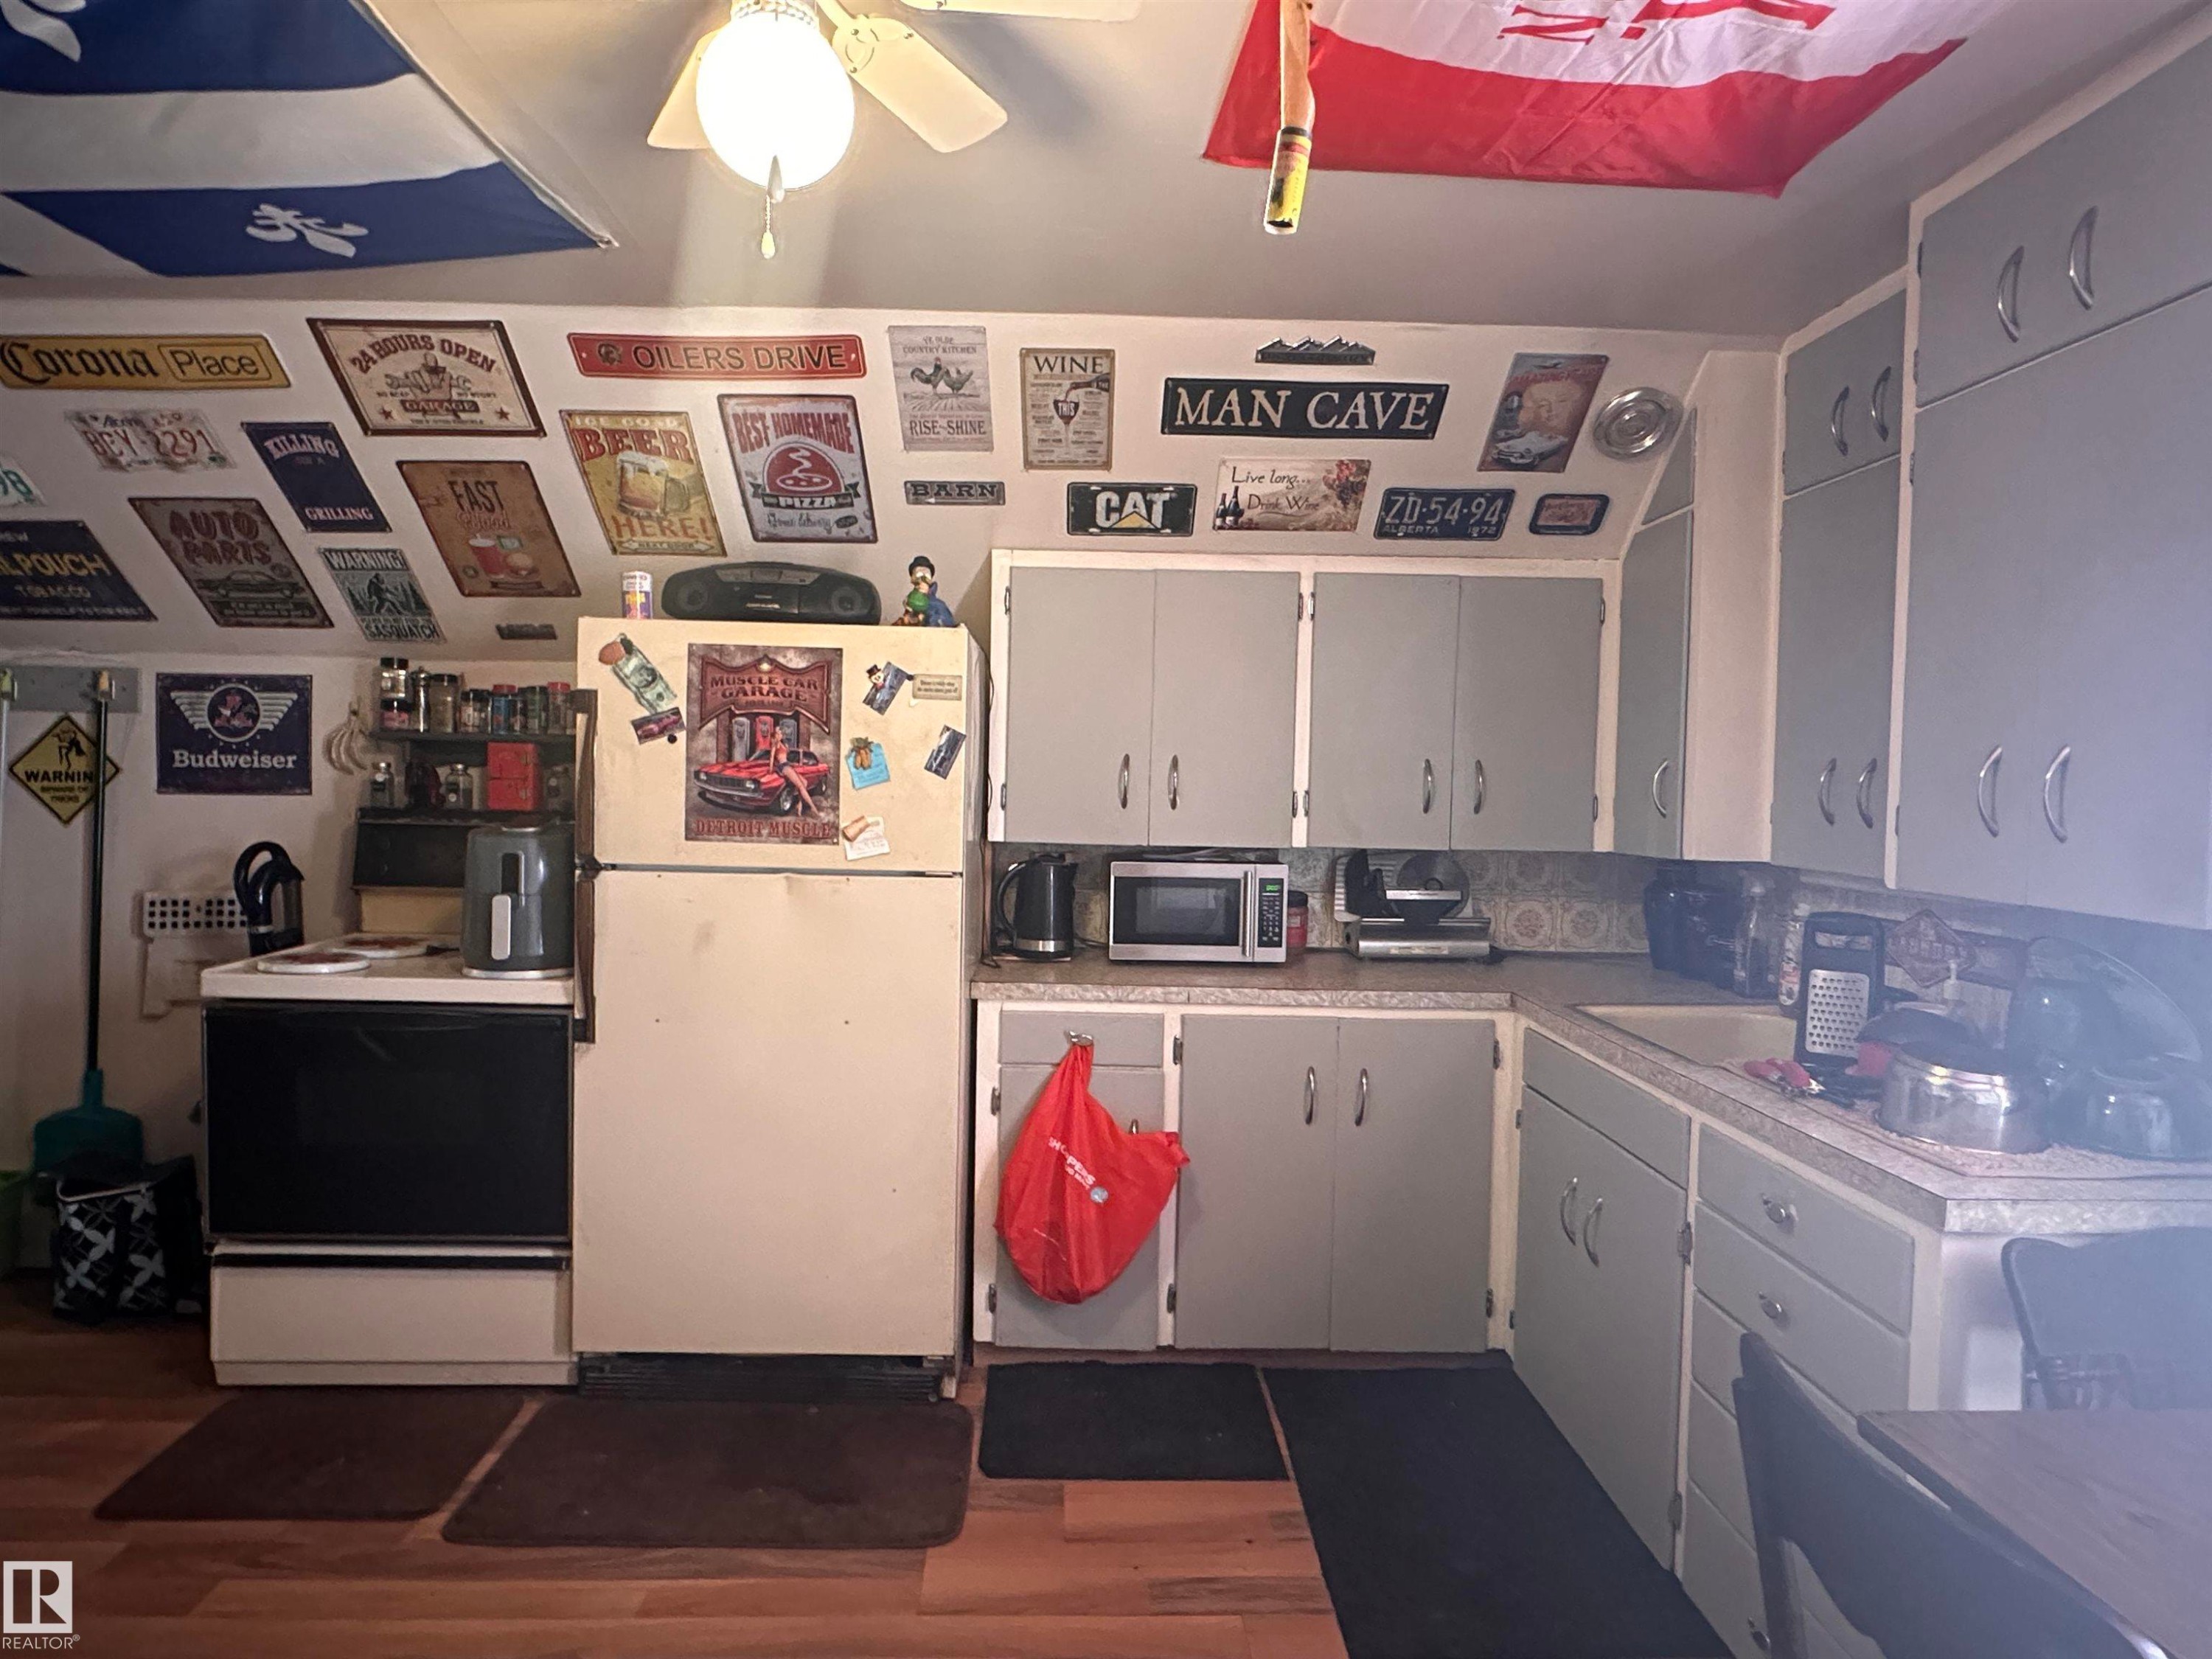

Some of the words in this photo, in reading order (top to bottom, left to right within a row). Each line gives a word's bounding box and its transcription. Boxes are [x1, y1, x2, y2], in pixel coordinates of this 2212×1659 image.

[351, 349, 378, 374] 24
[369, 334, 435, 359] HOURS
[440, 338, 496, 372] OPEN
[633, 344, 744, 369] OILERS
[754, 344, 847, 369] DRIVE
[903, 346, 940, 354] COUNTRY
[942, 346, 977, 354] KITCHEN
[0, 342, 159, 384] Corona
[170, 349, 259, 377] Place
[1034, 355, 1104, 373] WINE
[406, 401, 476, 411] GARAGE
[1057, 402, 1076, 417] THIS
[1175, 387, 1292, 428] MAN
[1306, 391, 1434, 430] CAVE
[575, 415, 610, 425] ICE
[622, 417, 680, 428] COLD
[910, 420, 939, 436] RISE
[947, 420, 986, 435] SHINE
[732, 412, 770, 453] BEST
[771, 412, 855, 453] HOMEMADE
[572, 428, 695, 465] BEER
[1232, 466, 1265, 484] Live
[1270, 469, 1311, 490] long...
[448, 481, 504, 512] FAST
[911, 484, 997, 497] BARN
[778, 496, 837, 508] PIZZA
[1096, 491, 1171, 529] CAT
[1248, 494, 1282, 510] Drink
[1285, 495, 1320, 510] Wine
[305, 507, 374, 521] GRILLING
[170, 510, 258, 540] AUTO
[611, 515, 712, 541] HERE!
[1382, 526, 1438, 534] ALBERTA
[1467, 526, 1496, 534] 1972
[183, 540, 272, 566] PARTS
[324, 552, 407, 570] WARNING!
[13, 554, 111, 576] POUCH
[366, 624, 440, 639] SASQUATCH
[710, 676, 779, 687] MUSCLE
[783, 677, 818, 690] CAR
[721, 686, 807, 702] GARAGE
[173, 750, 297, 768] Budweiser
[24, 771, 94, 782] WARNIN
[696, 819, 763, 836] DETROIT
[769, 821, 831, 839] MUSCLE
